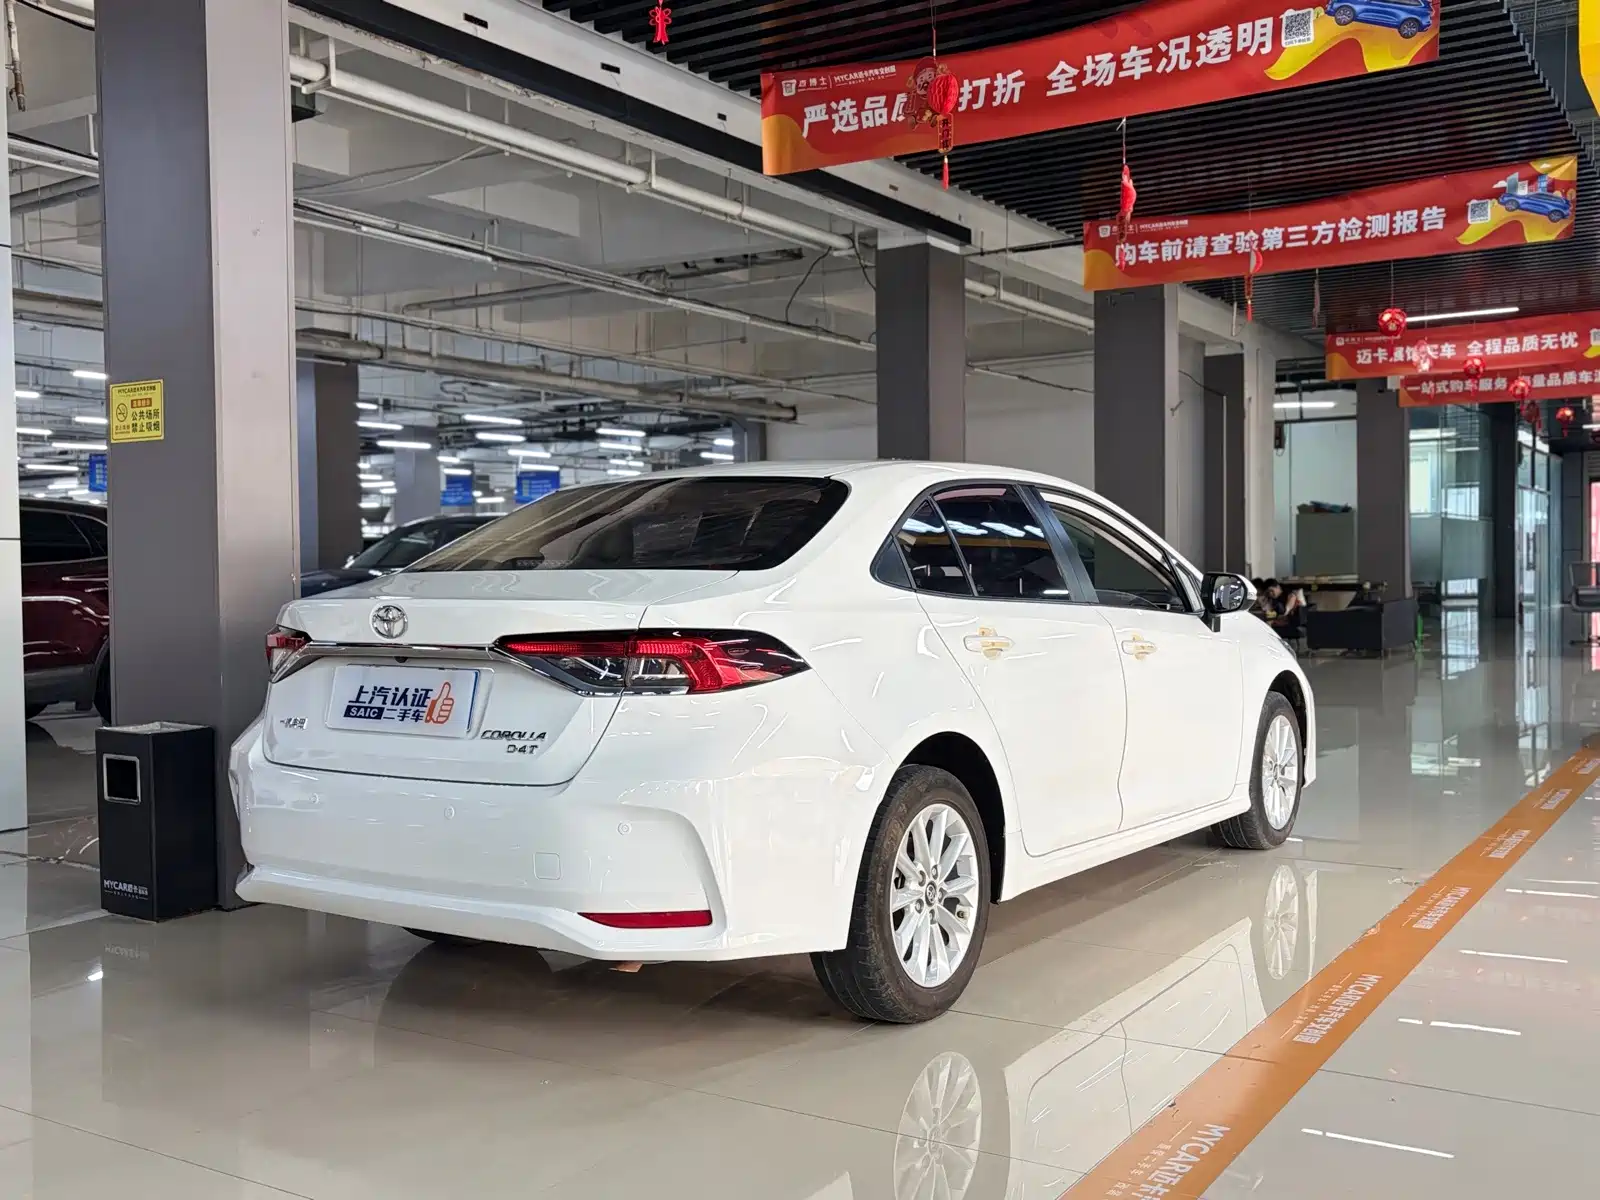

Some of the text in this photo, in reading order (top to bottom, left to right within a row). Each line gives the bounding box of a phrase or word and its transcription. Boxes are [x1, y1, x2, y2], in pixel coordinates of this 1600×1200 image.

[1046, 16, 1274, 97] 全场车况透明
[1114, 205, 1447, 268] 购车前请查验第三方检测报告
[1466, 331, 1579, 356] 全程品质无忧
[131, 408, 160, 421] 公共场所
[131, 420, 160, 433] 禁止吸烟
[348, 685, 433, 708] 上汽认证
[349, 707, 379, 718] SAIC
[383, 708, 426, 723] 二手车
[481, 730, 547, 742] COROLLA
